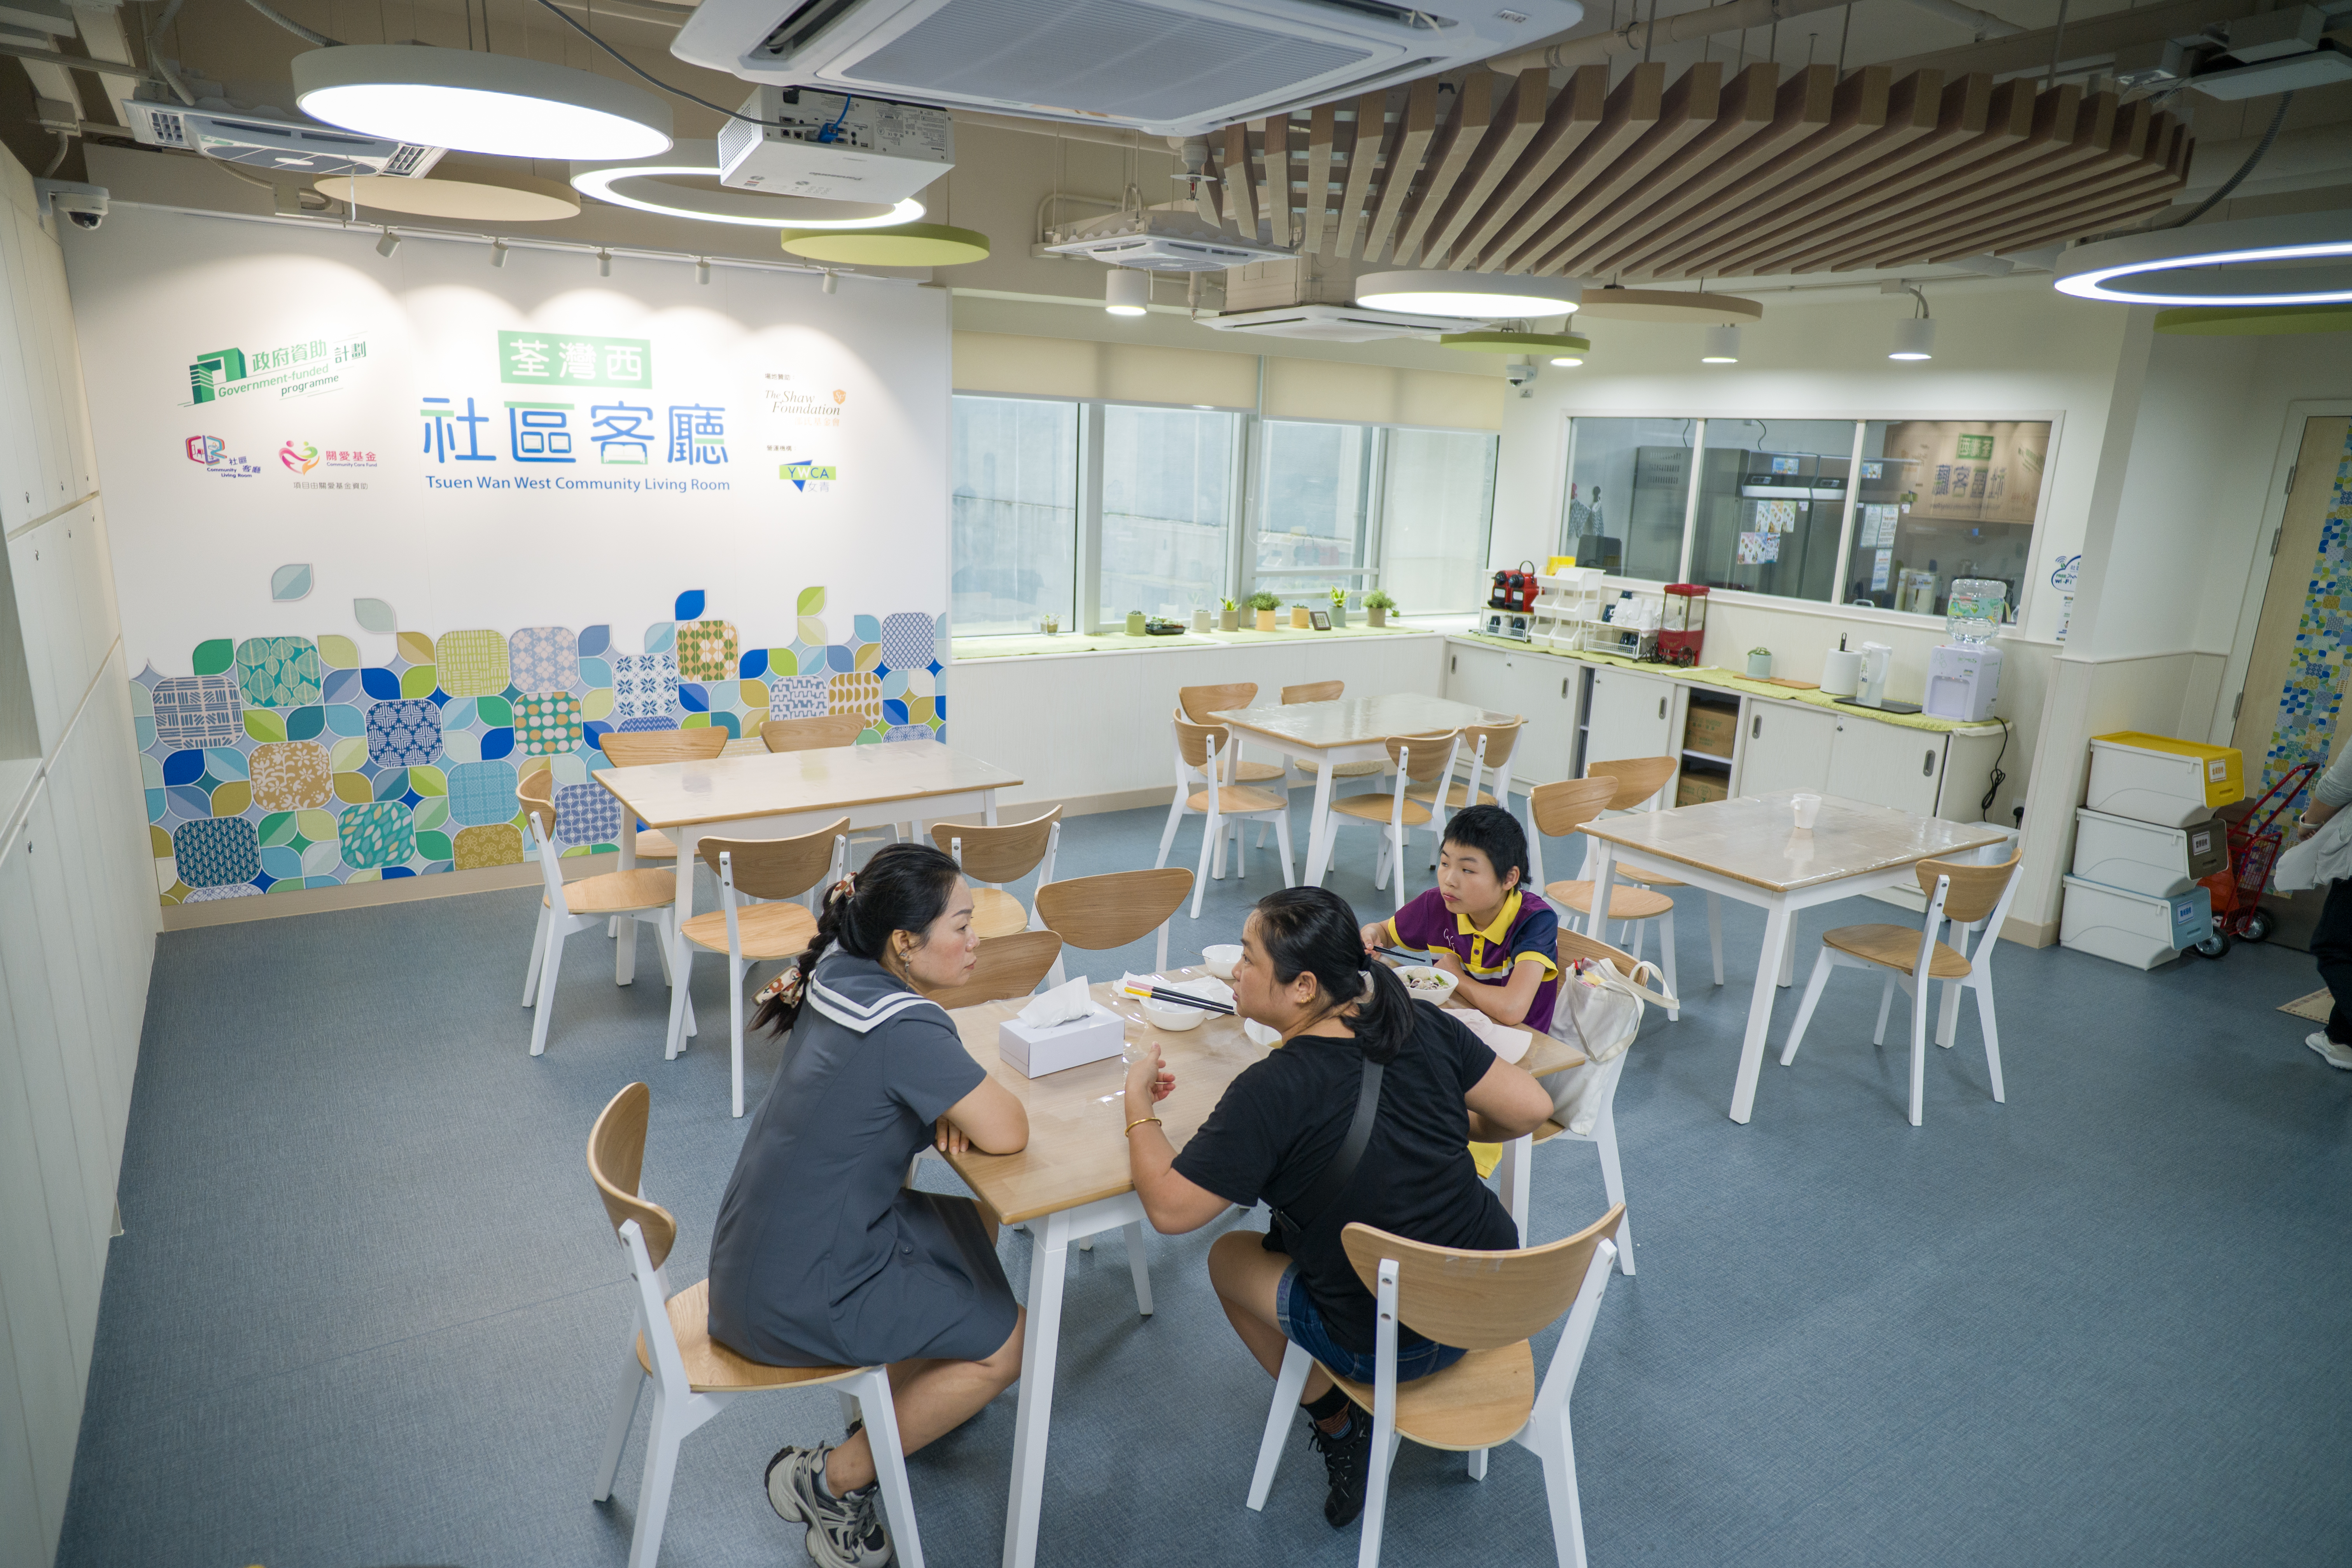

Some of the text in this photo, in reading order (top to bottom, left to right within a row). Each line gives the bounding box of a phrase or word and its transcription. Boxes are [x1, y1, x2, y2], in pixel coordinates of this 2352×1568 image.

[808, 172, 863, 181] Panasonic
[252, 340, 367, 372] 政府資助 計劃
[510, 339, 642, 381] 荃灣西
[219, 364, 329, 398] Government-funded
[281, 374, 339, 397] programme
[765, 390, 815, 403] The Shaw
[772, 401, 840, 415] Foundation
[420, 397, 728, 465] 社區客廳
[229, 456, 247, 466] 社區
[326, 451, 376, 462] 關愛基金
[788, 467, 829, 479] YWCA
[426, 476, 730, 493] Tsuen Wan West Community Living Room
[807, 481, 830, 492] 女青
